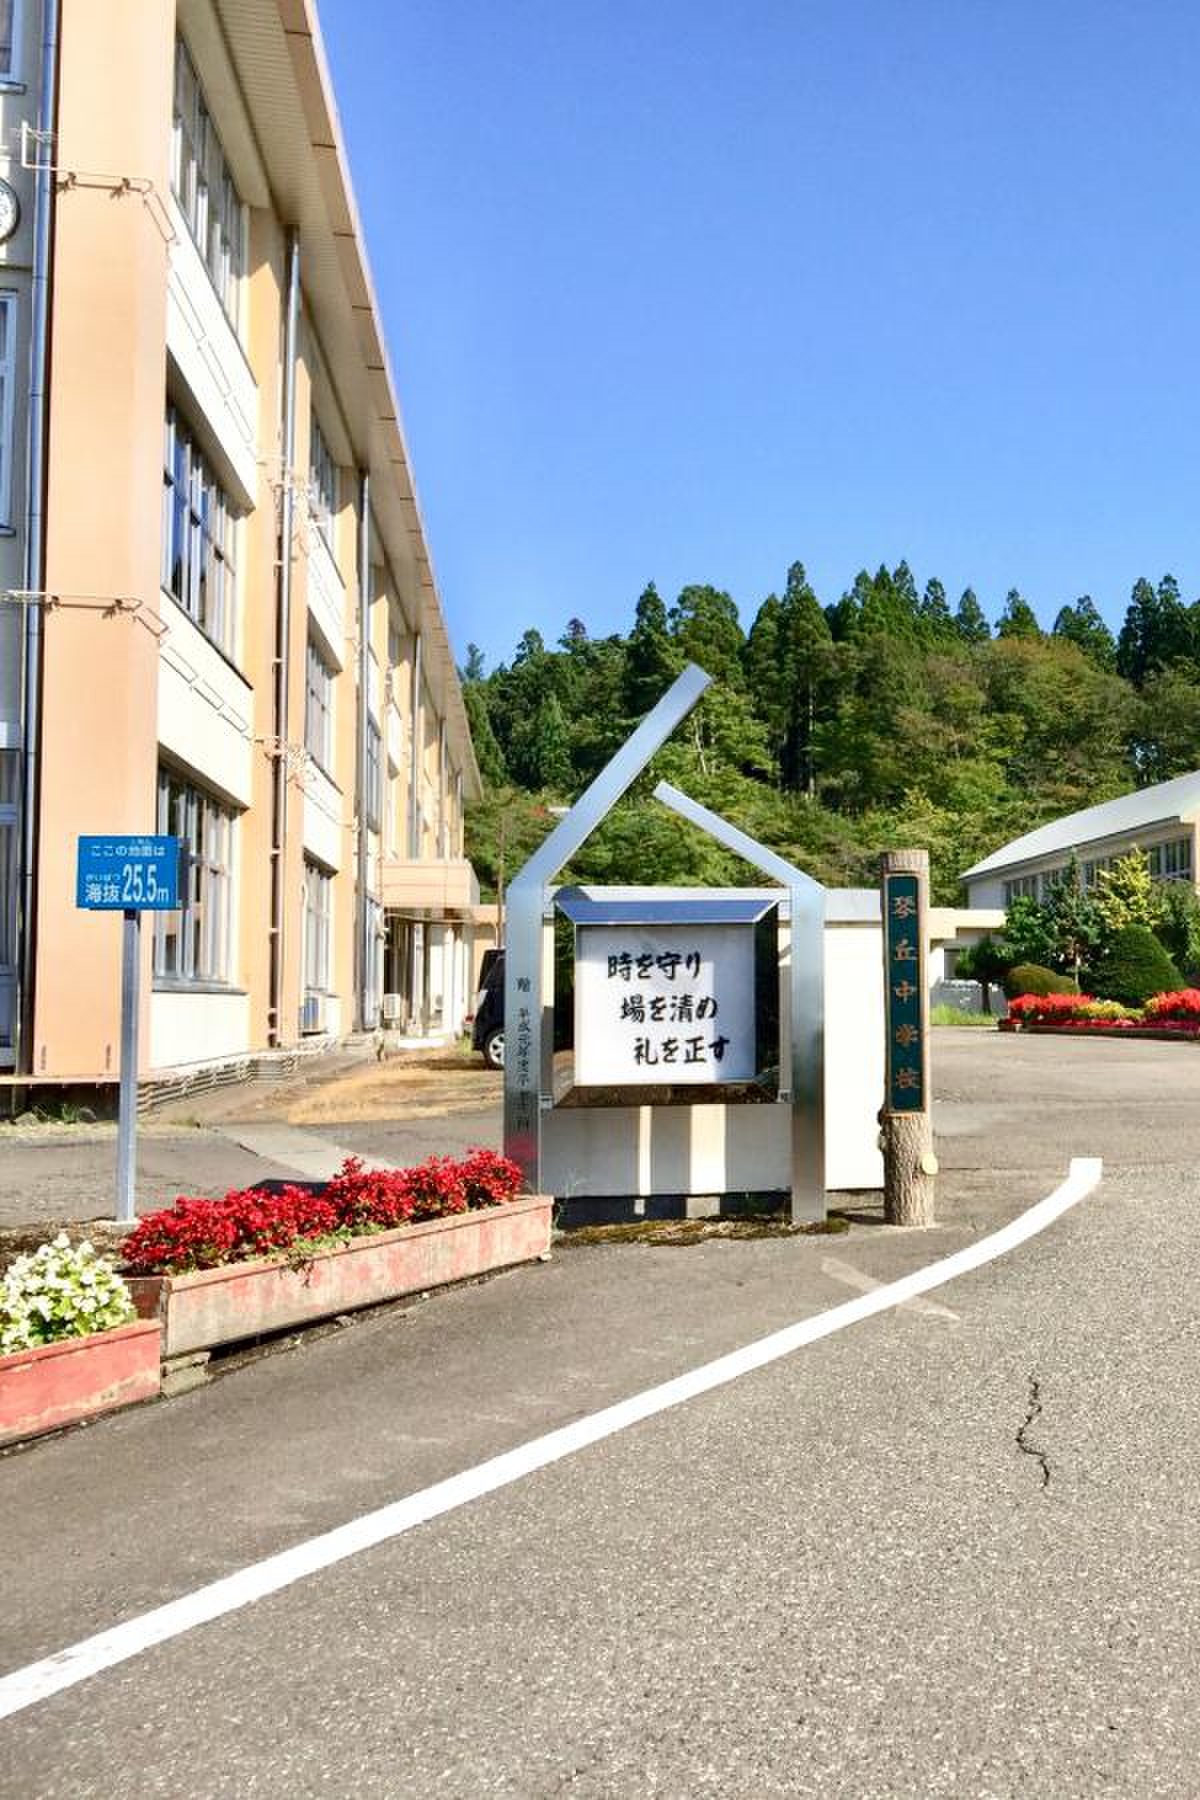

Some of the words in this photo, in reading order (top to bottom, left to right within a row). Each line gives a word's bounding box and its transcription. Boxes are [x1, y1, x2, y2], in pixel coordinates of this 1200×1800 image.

[607, 951, 702, 982] 時を守り
[621, 993, 719, 1024] 場を清め
[633, 1035, 731, 1066] 礼を正す
